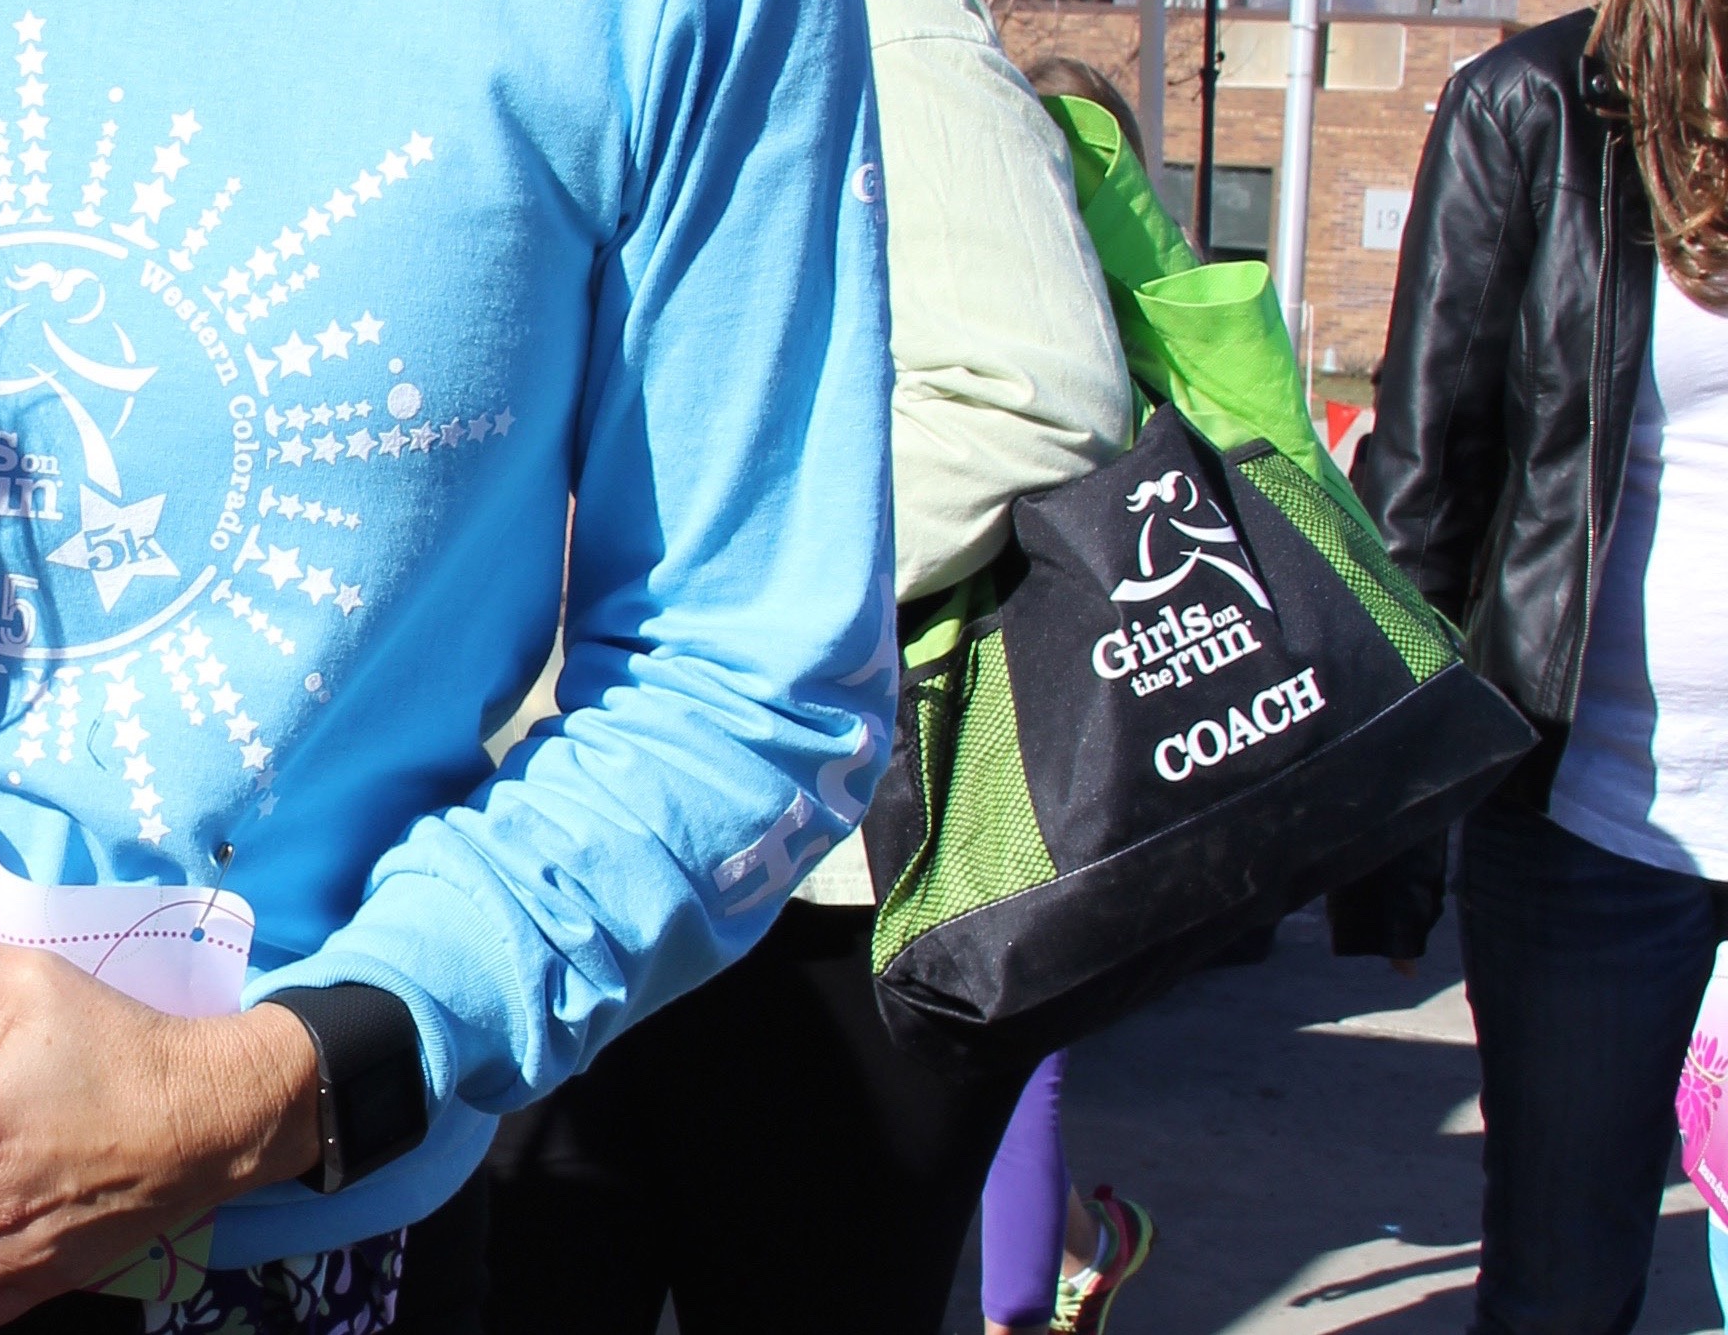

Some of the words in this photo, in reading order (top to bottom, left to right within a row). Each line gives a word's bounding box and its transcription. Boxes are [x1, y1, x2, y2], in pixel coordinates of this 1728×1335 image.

[138, 259, 240, 387] Western
[209, 394, 261, 552] Colorado
[20, 453, 61, 475] on
[83, 522, 162, 572] 5k
[1092, 602, 1213, 680] Girls
[1211, 603, 1243, 628] on
[1130, 667, 1175, 697] the
[1166, 620, 1262, 688] run
[1153, 666, 1326, 782] COACH
